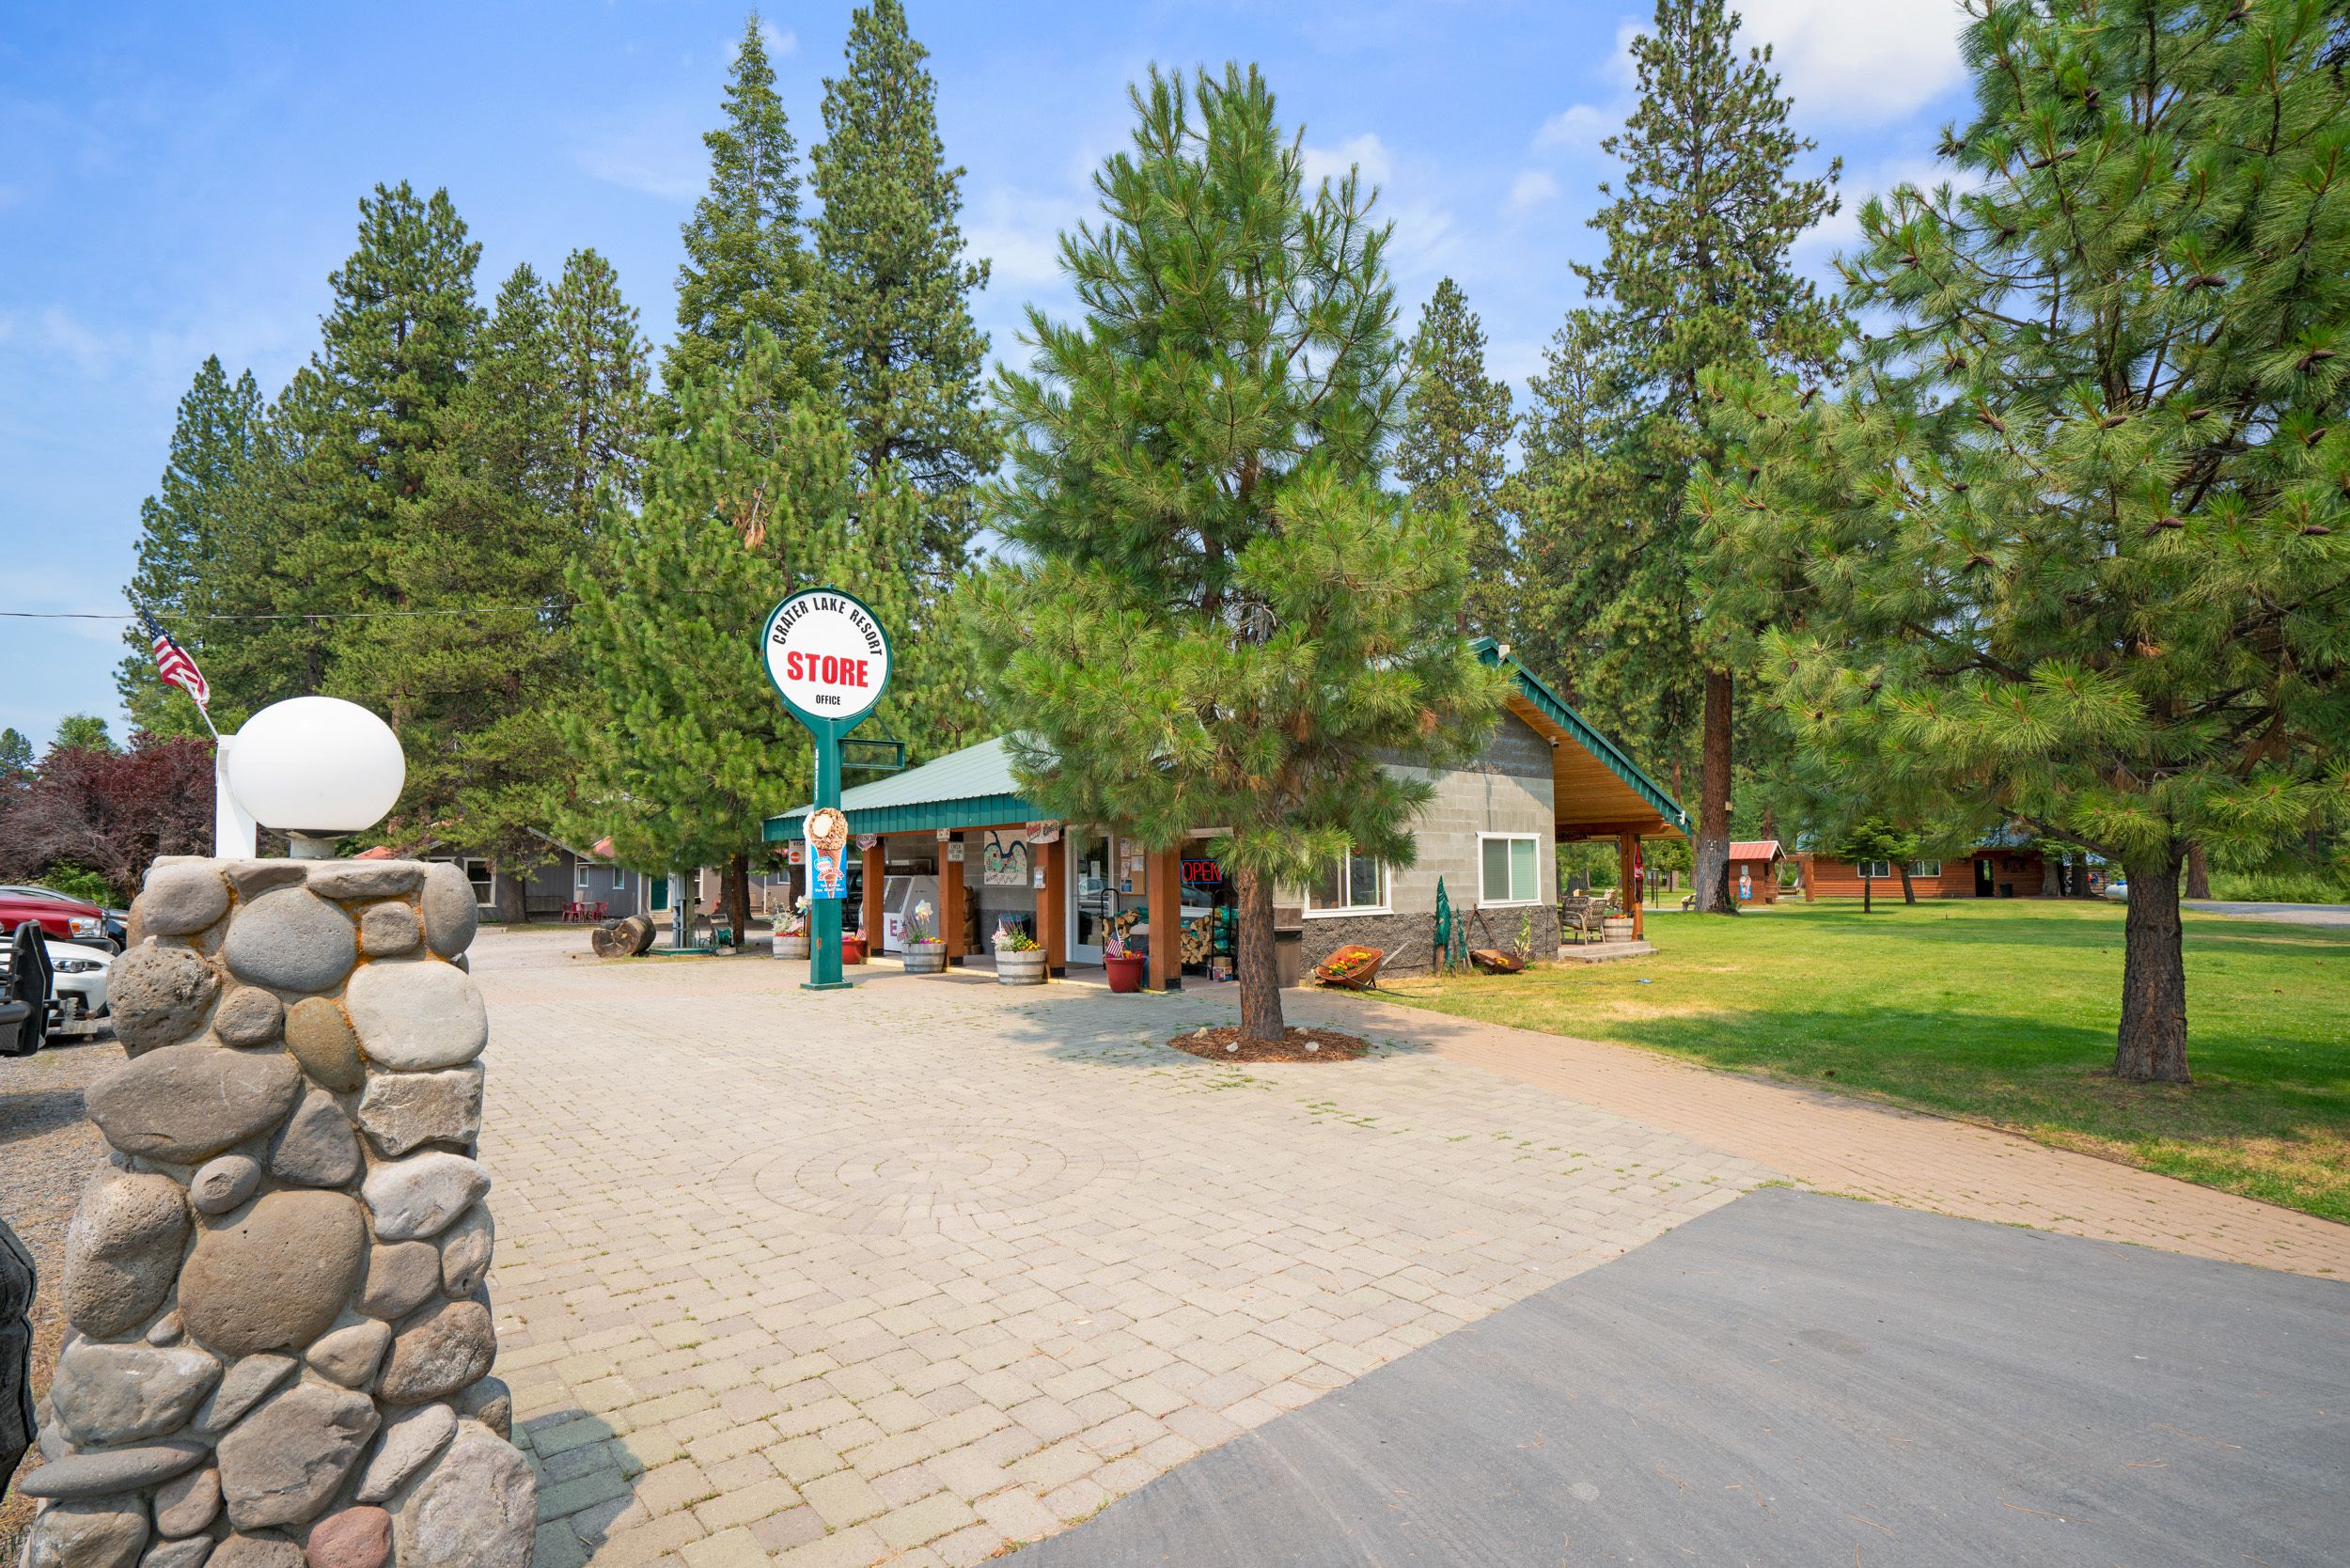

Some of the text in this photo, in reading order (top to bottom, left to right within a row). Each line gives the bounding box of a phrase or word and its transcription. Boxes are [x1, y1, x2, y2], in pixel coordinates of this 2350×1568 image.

[773, 597, 882, 656] CRATER LAKE RESORT
[787, 651, 869, 687] STORE
[816, 694, 841, 705] OFFICE
[1182, 861, 1221, 882] OPEN
